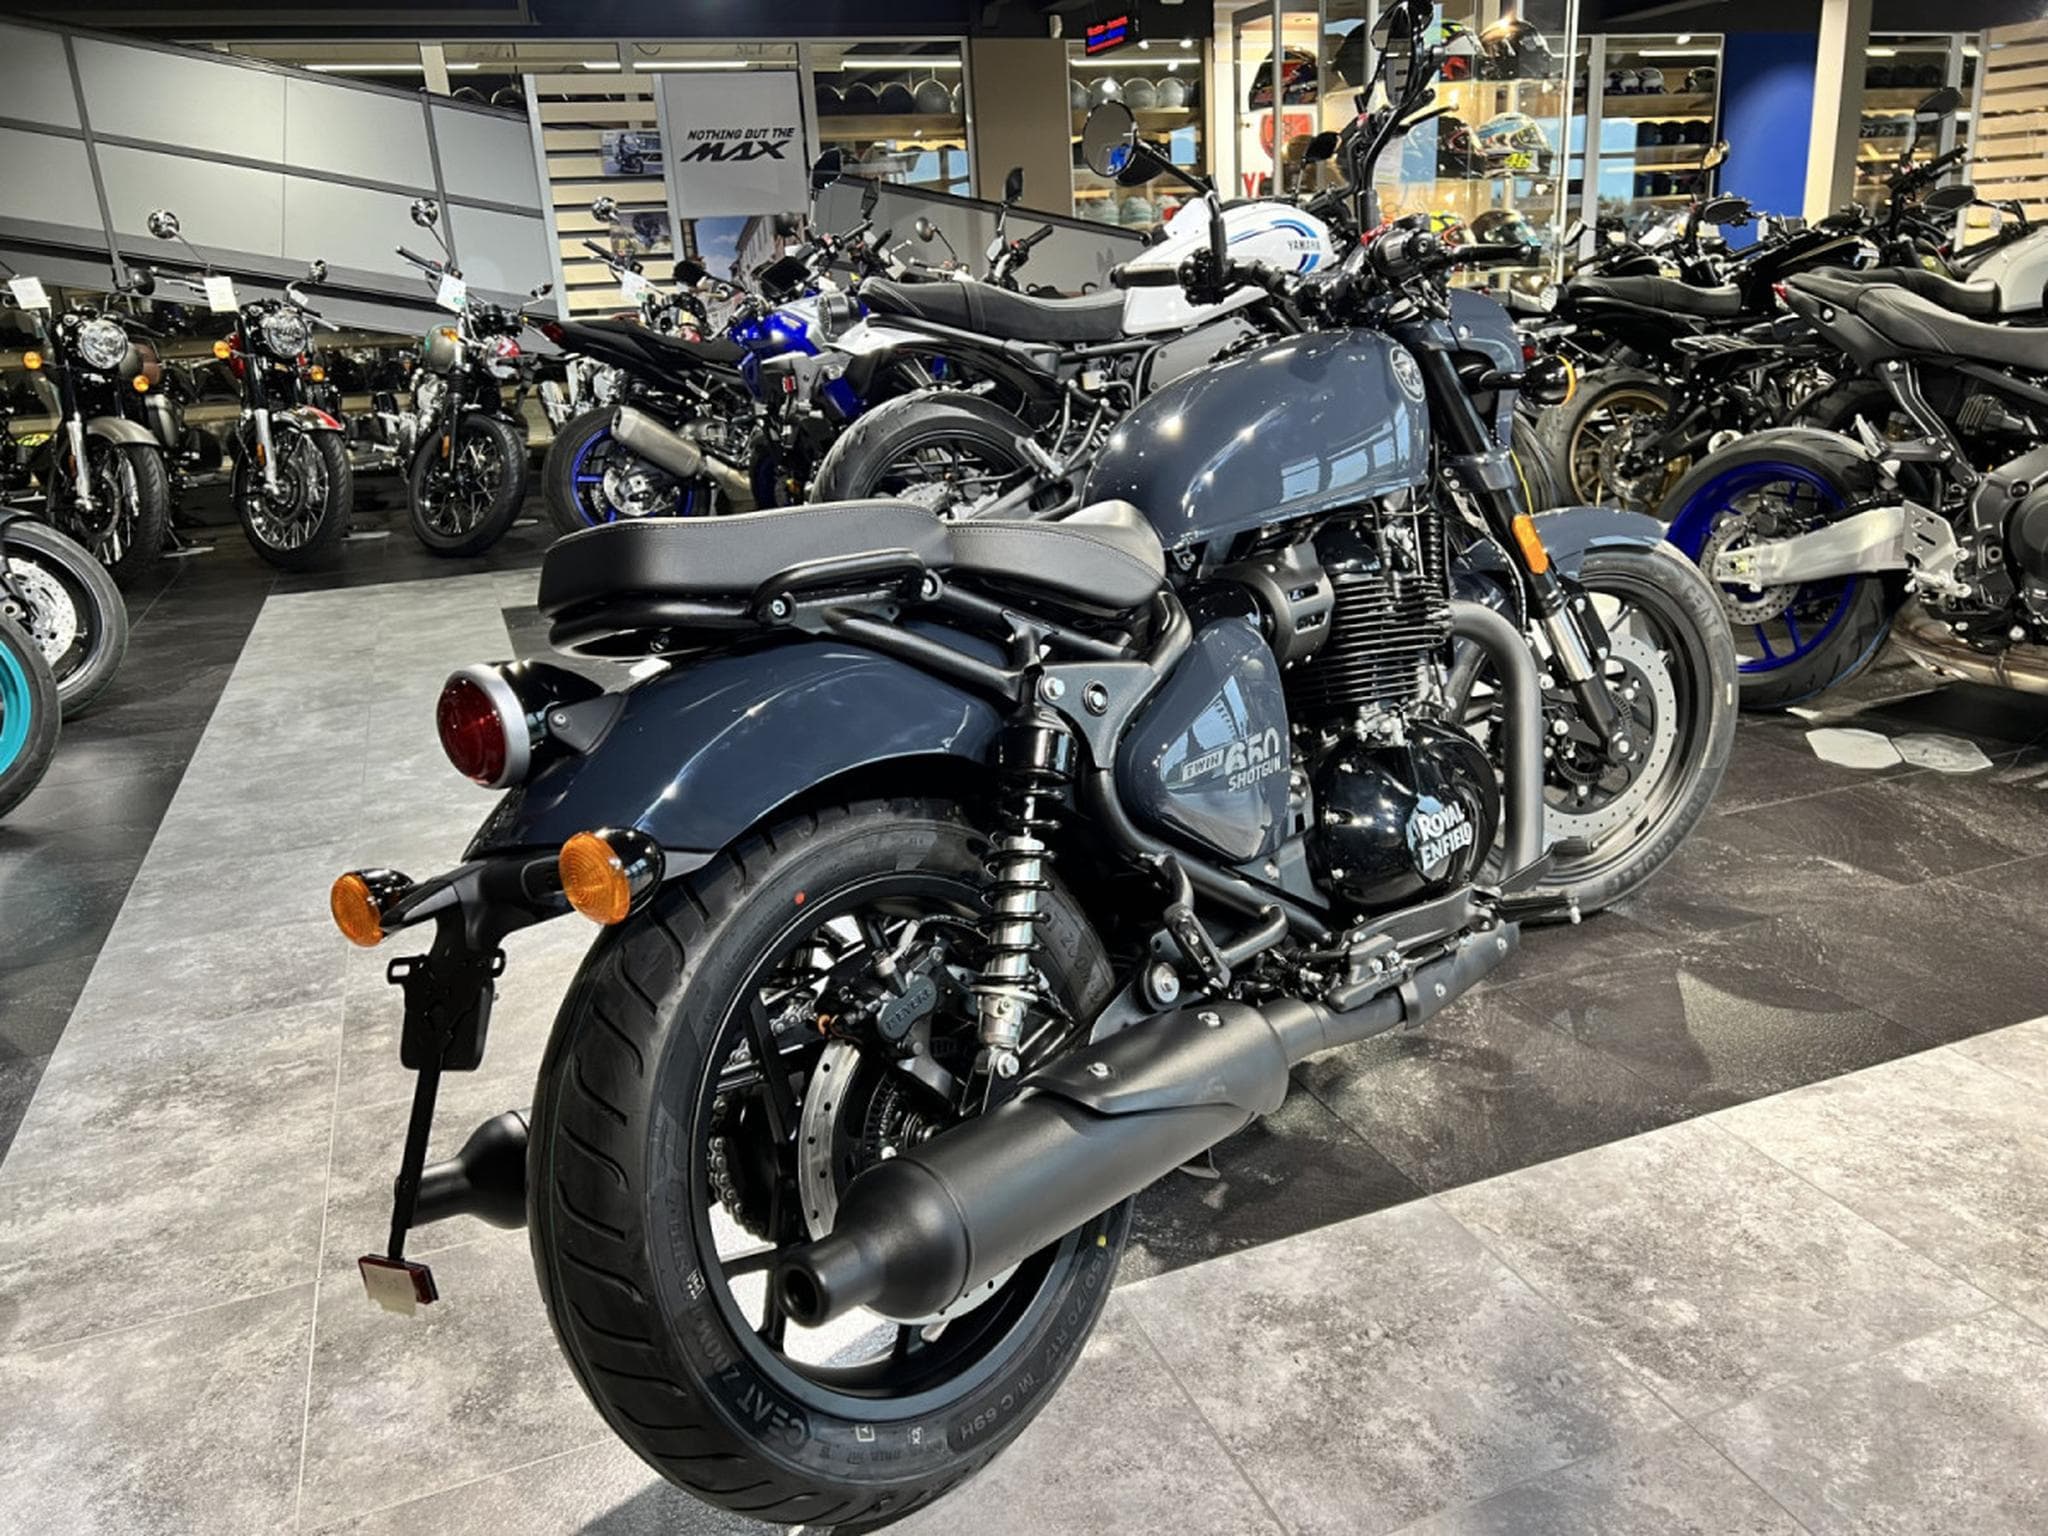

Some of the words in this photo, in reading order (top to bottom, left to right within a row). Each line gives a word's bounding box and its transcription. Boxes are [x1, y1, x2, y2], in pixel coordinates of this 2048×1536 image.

[680, 140, 791, 162] MAX
[687, 129, 743, 141] NOTHING
[744, 128, 770, 140] BUT
[772, 127, 796, 139] THE
[1225, 727, 1280, 776] 650
[1228, 755, 1281, 792] SHOTGUN
[1416, 801, 1466, 842] ROYAL
[1419, 821, 1473, 872] ENFIELD
[735, 1383, 807, 1447] CEAT
[960, 1406, 998, 1440] 69H
